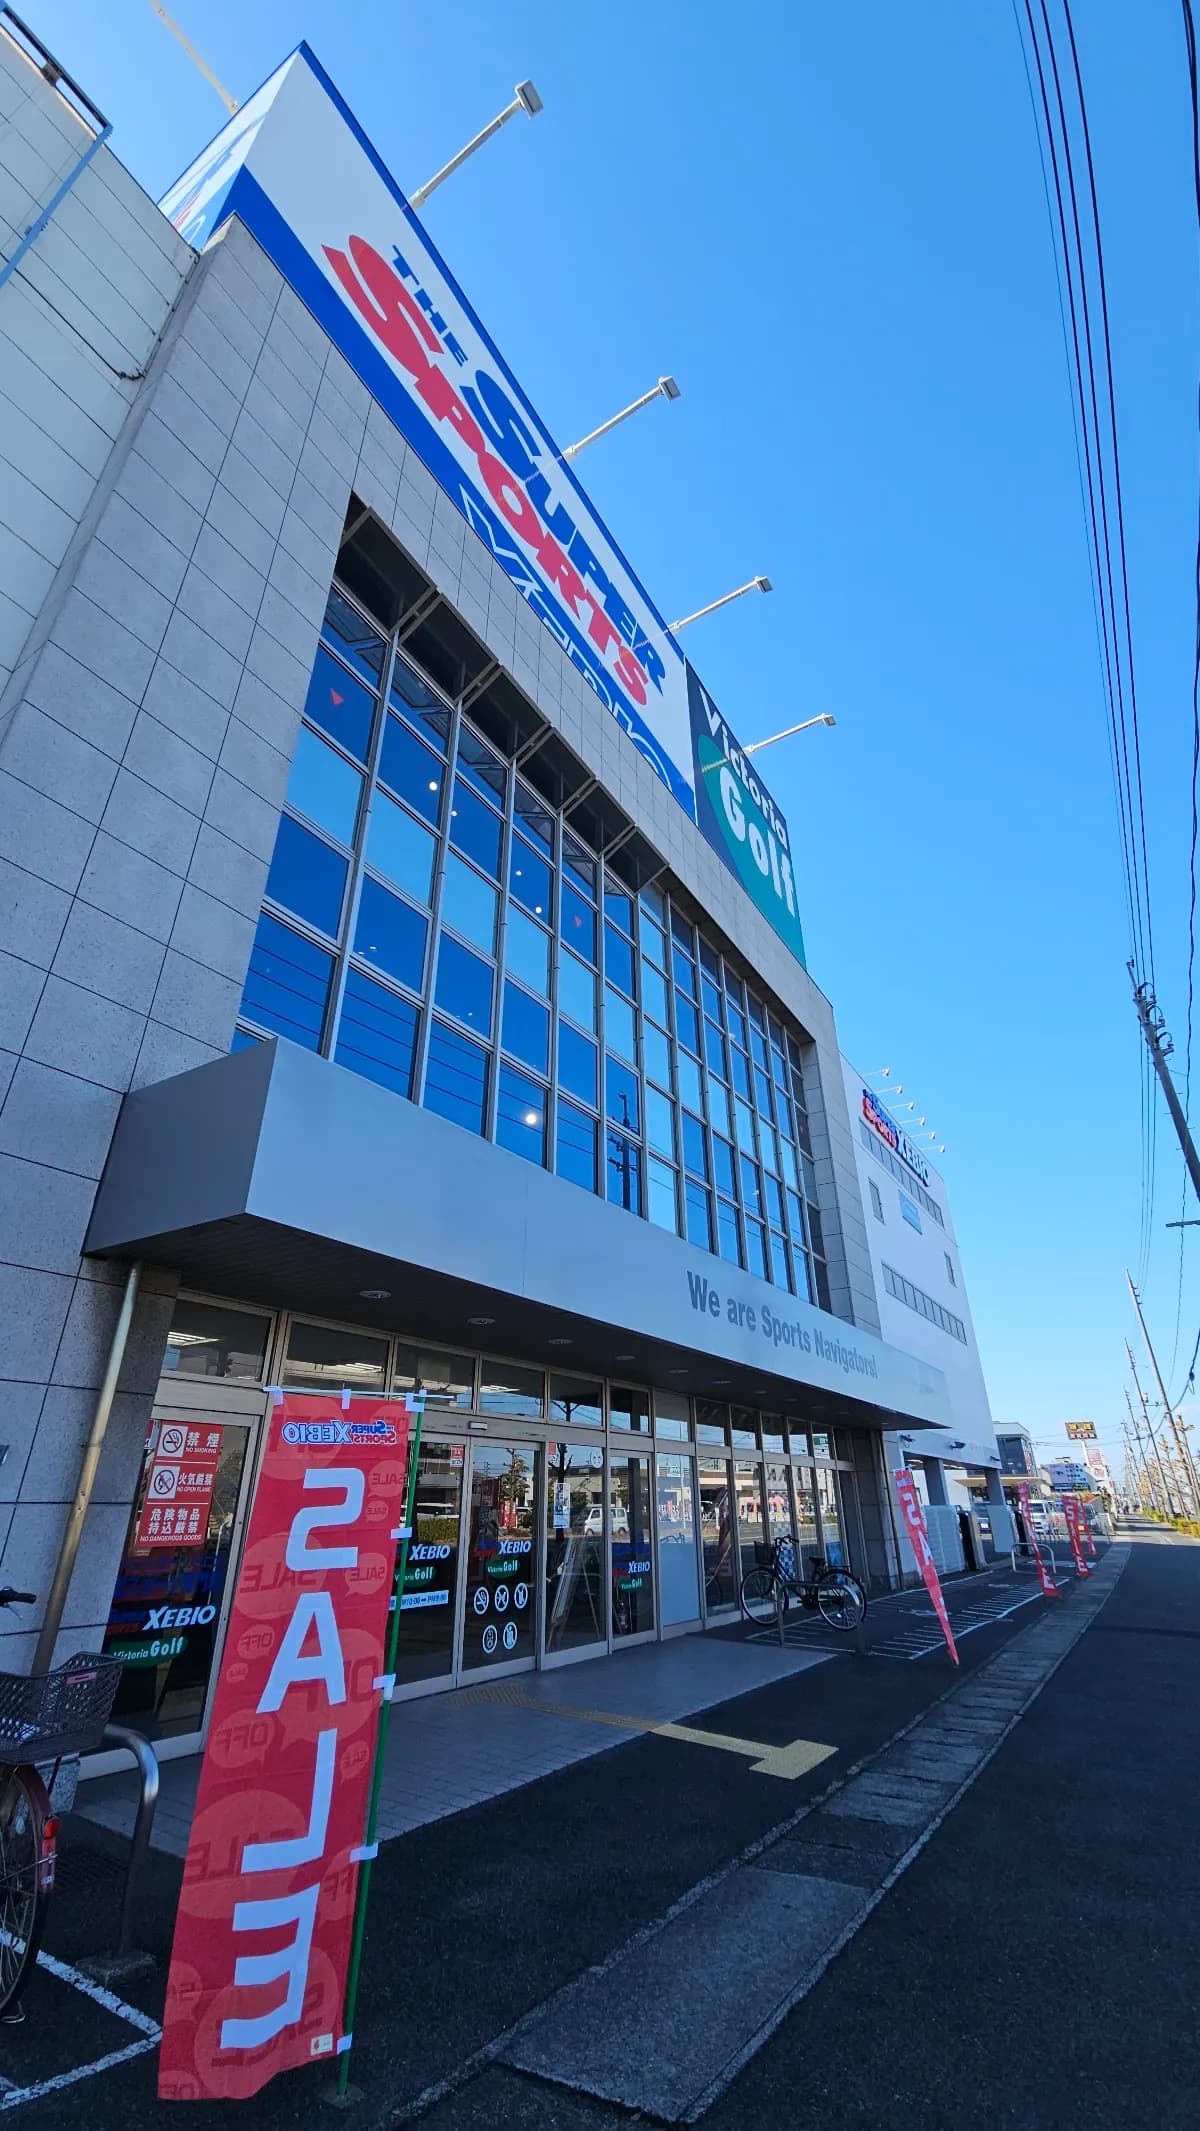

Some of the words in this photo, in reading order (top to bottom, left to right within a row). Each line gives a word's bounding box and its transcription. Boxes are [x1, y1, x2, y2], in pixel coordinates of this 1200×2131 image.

[321, 234, 648, 706] SPORTS
[392, 245, 468, 366] THE
[460, 369, 664, 696] SUPER
[699, 686, 787, 850] Victoria
[720, 766, 795, 917] Golf
[686, 1270, 720, 1318] We
[726, 1298, 756, 1331] are
[761, 1304, 811, 1353] Sports
[813, 1327, 878, 1379] Navigators!
[185, 1431, 220, 1448] 禁煙
[409, 1543, 451, 1561] XEBIO
[499, 1539, 532, 1555] XEBIO
[414, 1566, 434, 1580] Golf
[503, 1559, 518, 1572] Golf
[627, 1560, 650, 1574] XEBIO
[141, 1604, 217, 1631] XEBIO
[150, 1636, 185, 1657] Golf
